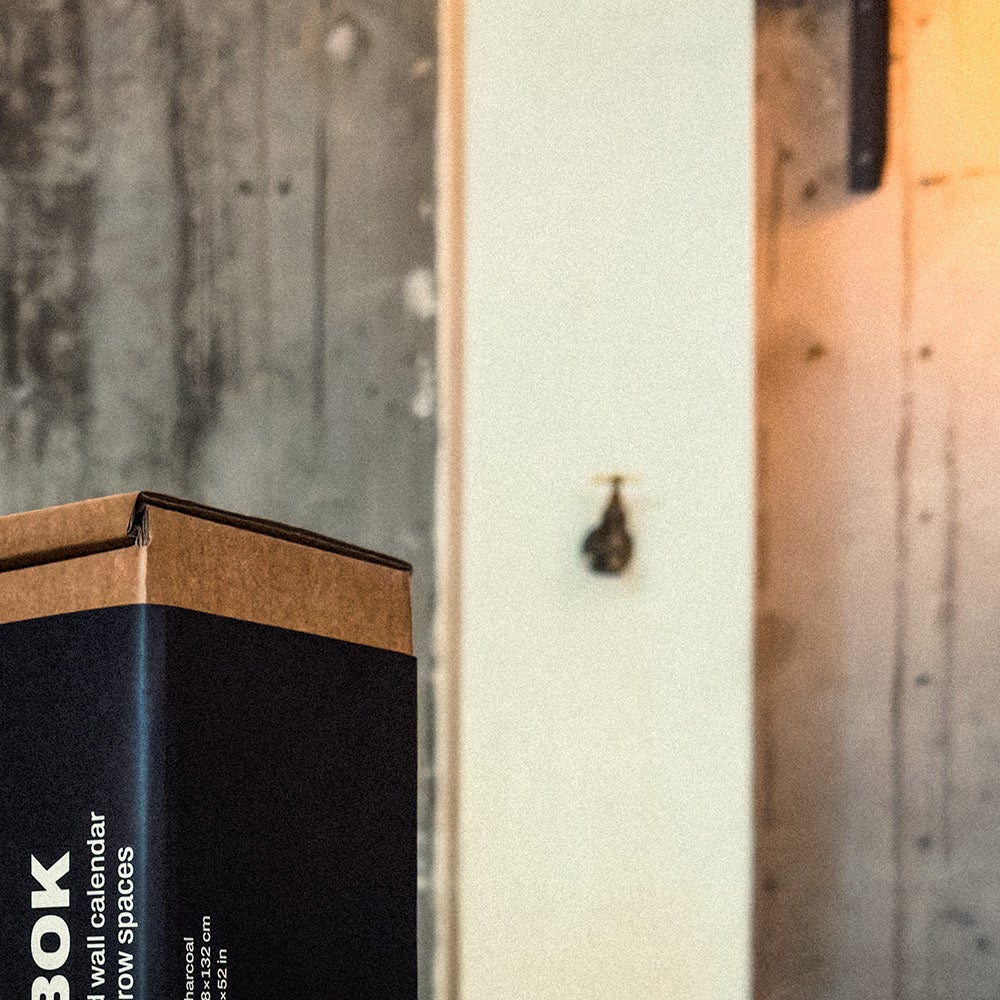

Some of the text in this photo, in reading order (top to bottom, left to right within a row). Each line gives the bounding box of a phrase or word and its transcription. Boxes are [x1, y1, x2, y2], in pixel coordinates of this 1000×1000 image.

[87, 811, 105, 929] calendar
[117, 846, 138, 945] spaces
[202, 915, 211, 942] cm
[87, 935, 105, 988] wall
[217, 949, 227, 964] in
